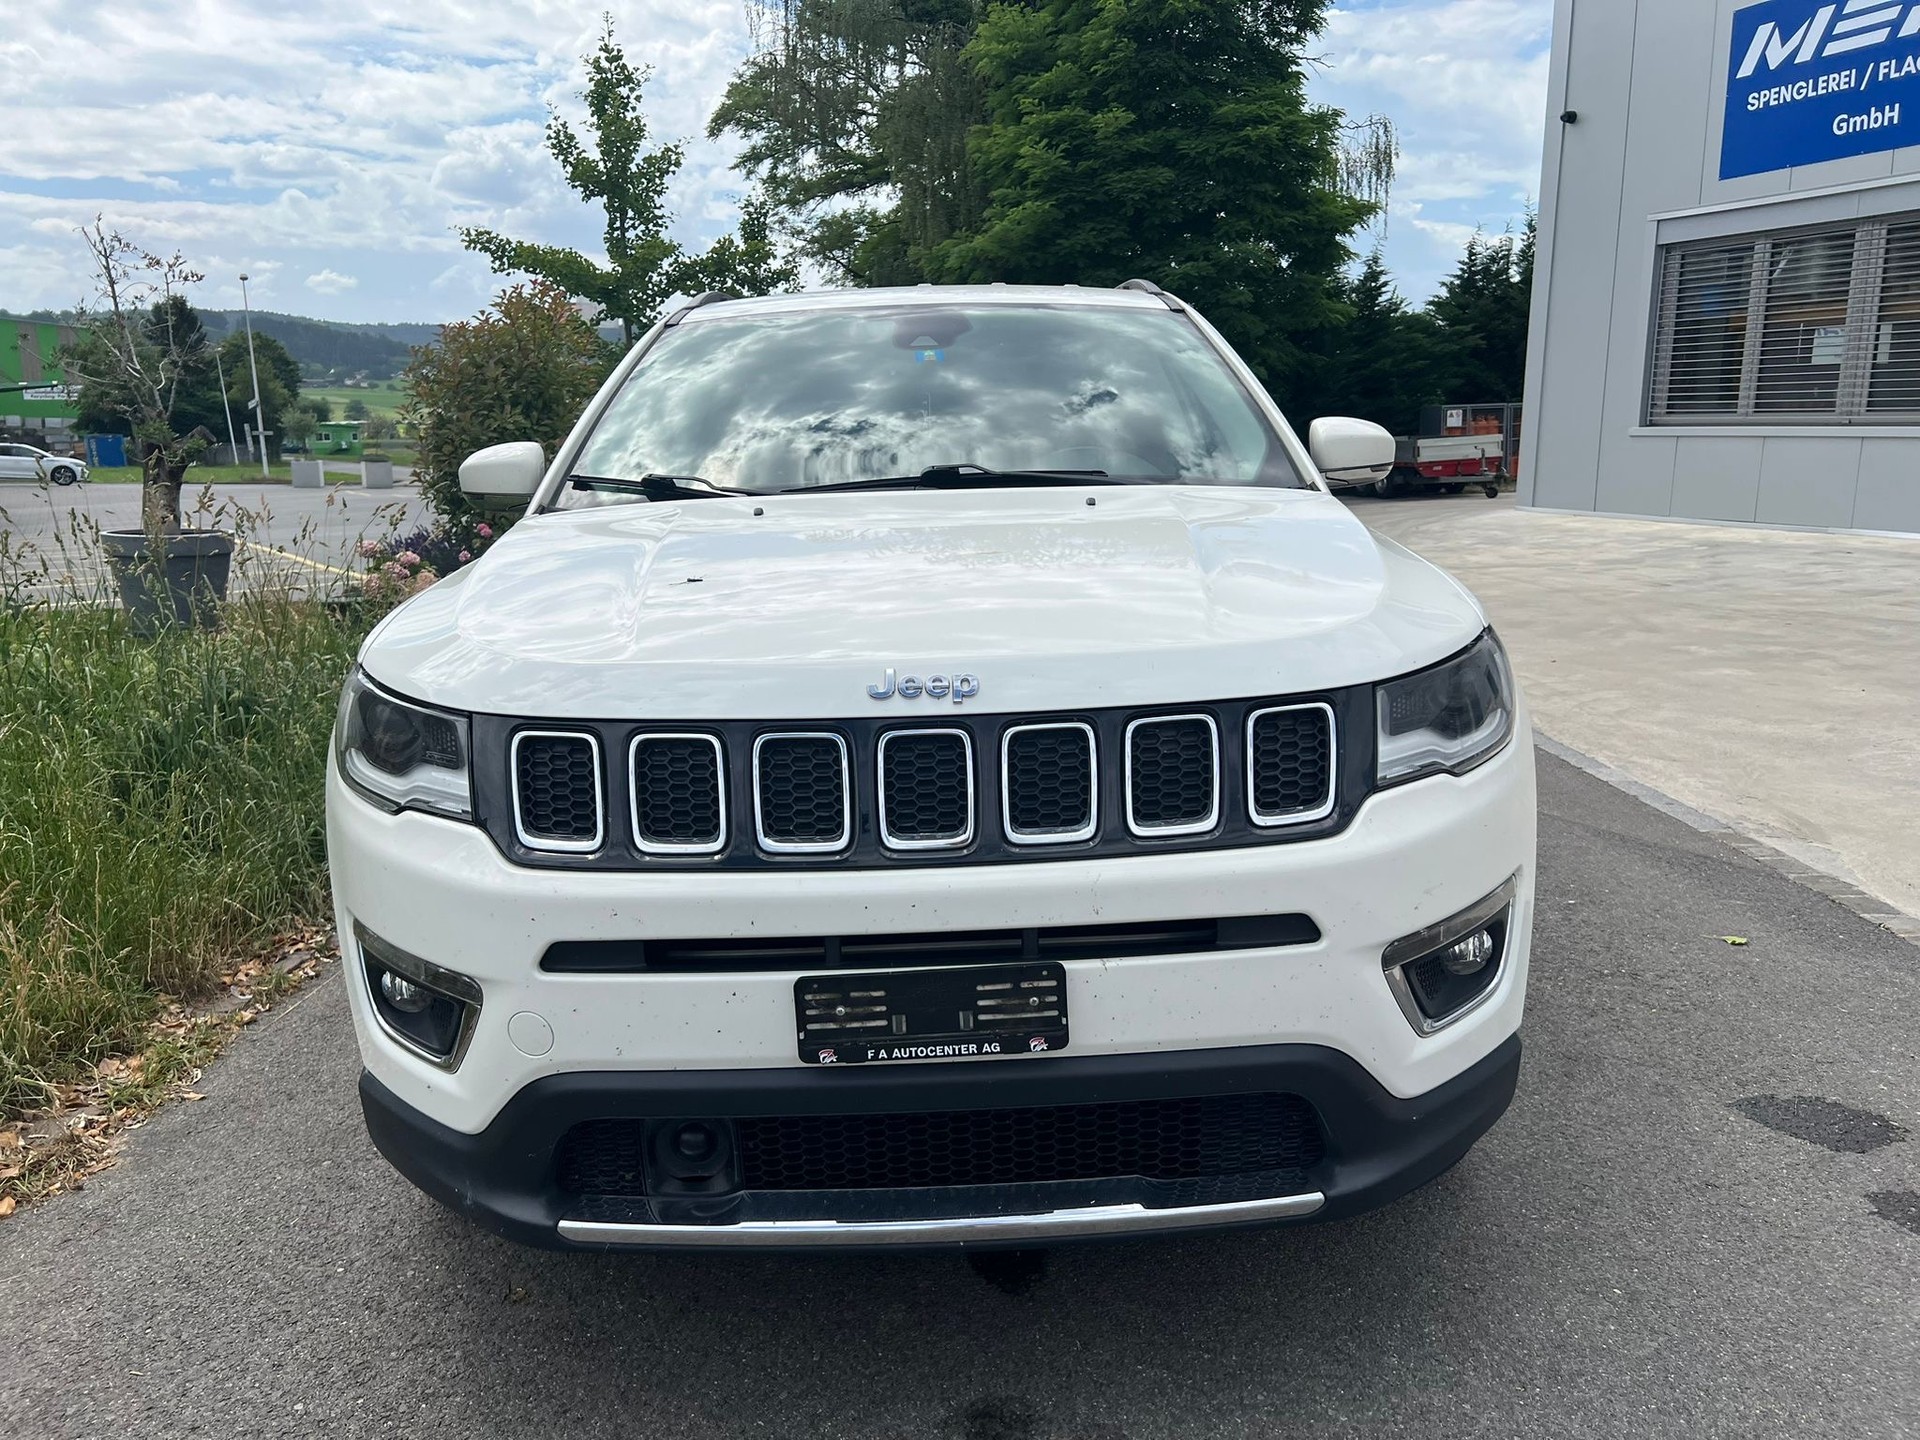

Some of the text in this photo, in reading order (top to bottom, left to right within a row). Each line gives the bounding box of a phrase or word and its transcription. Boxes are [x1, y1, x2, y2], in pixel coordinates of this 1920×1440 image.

[1747, 69, 1856, 111] SPENGLEREI
[1860, 62, 1875, 91] /
[1832, 103, 1900, 136] GmbH
[866, 667, 980, 705] Jeep
[867, 1042, 1001, 1060] F A AUTOCENTER AG
